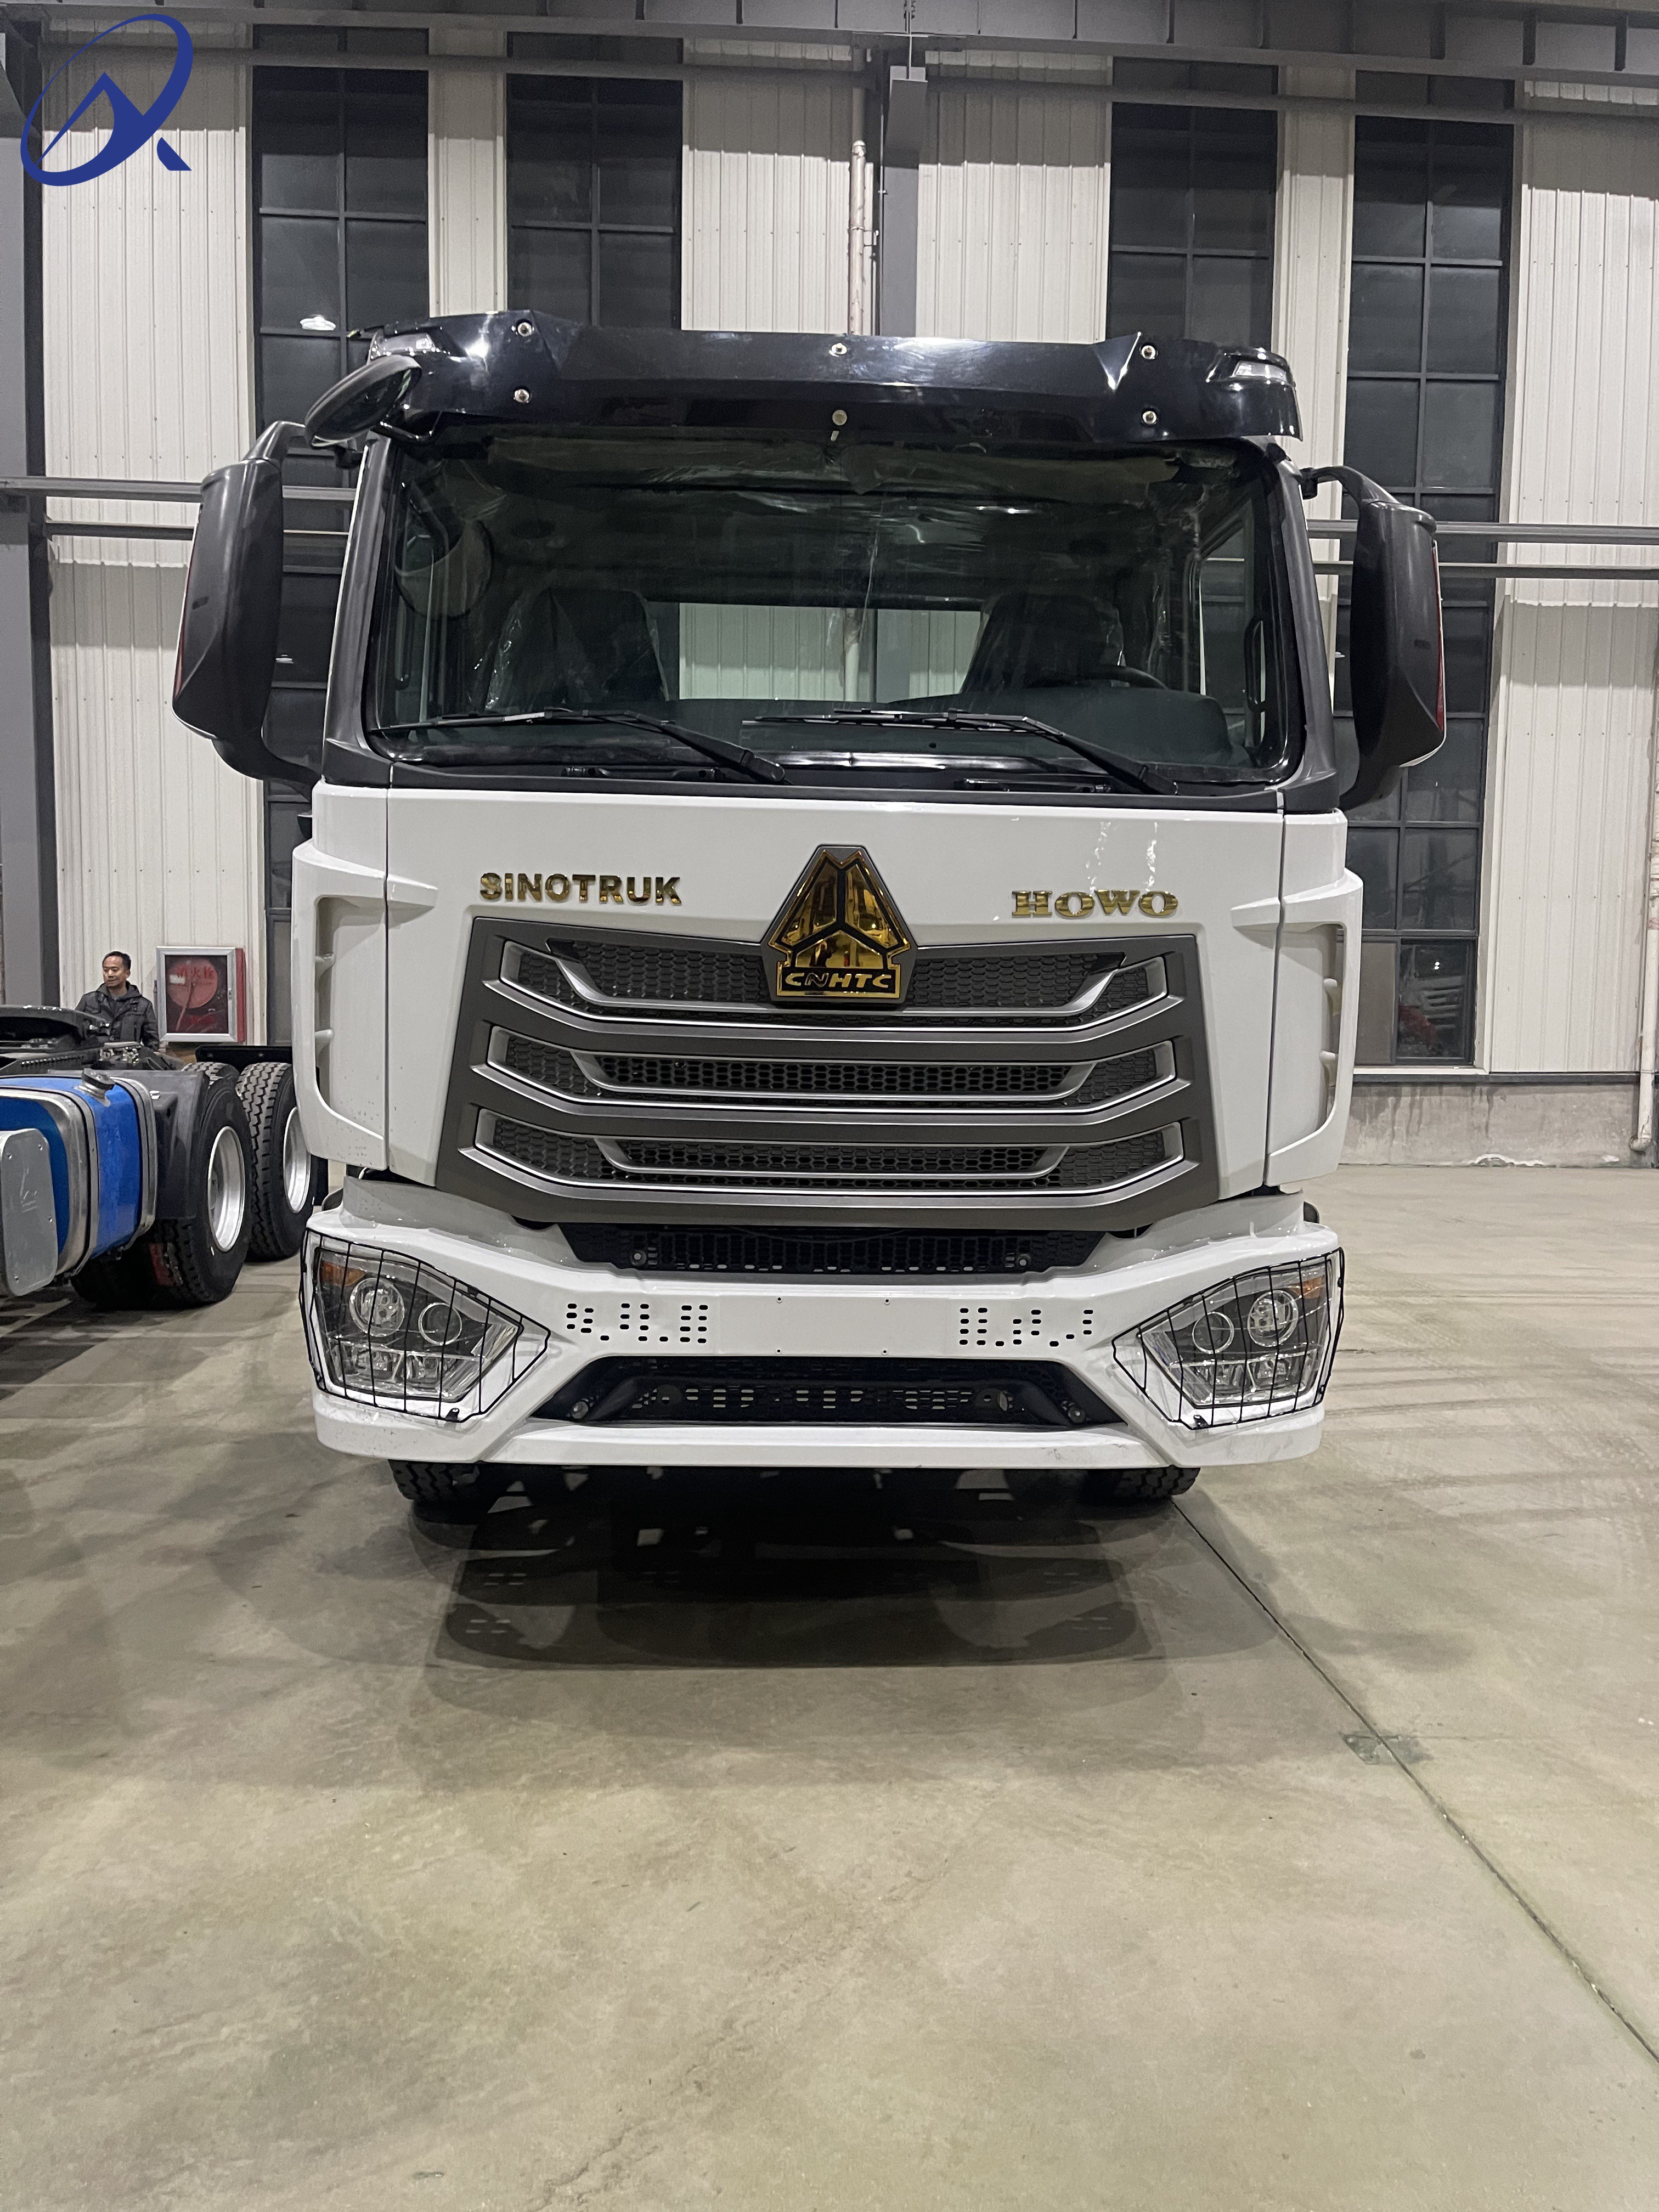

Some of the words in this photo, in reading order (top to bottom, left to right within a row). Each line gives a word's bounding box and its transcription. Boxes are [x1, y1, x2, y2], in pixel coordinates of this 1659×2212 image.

[479, 872, 681, 905] SINOTRUK
[1011, 889, 1178, 918] HOWO
[785, 972, 891, 988] CNHTC
